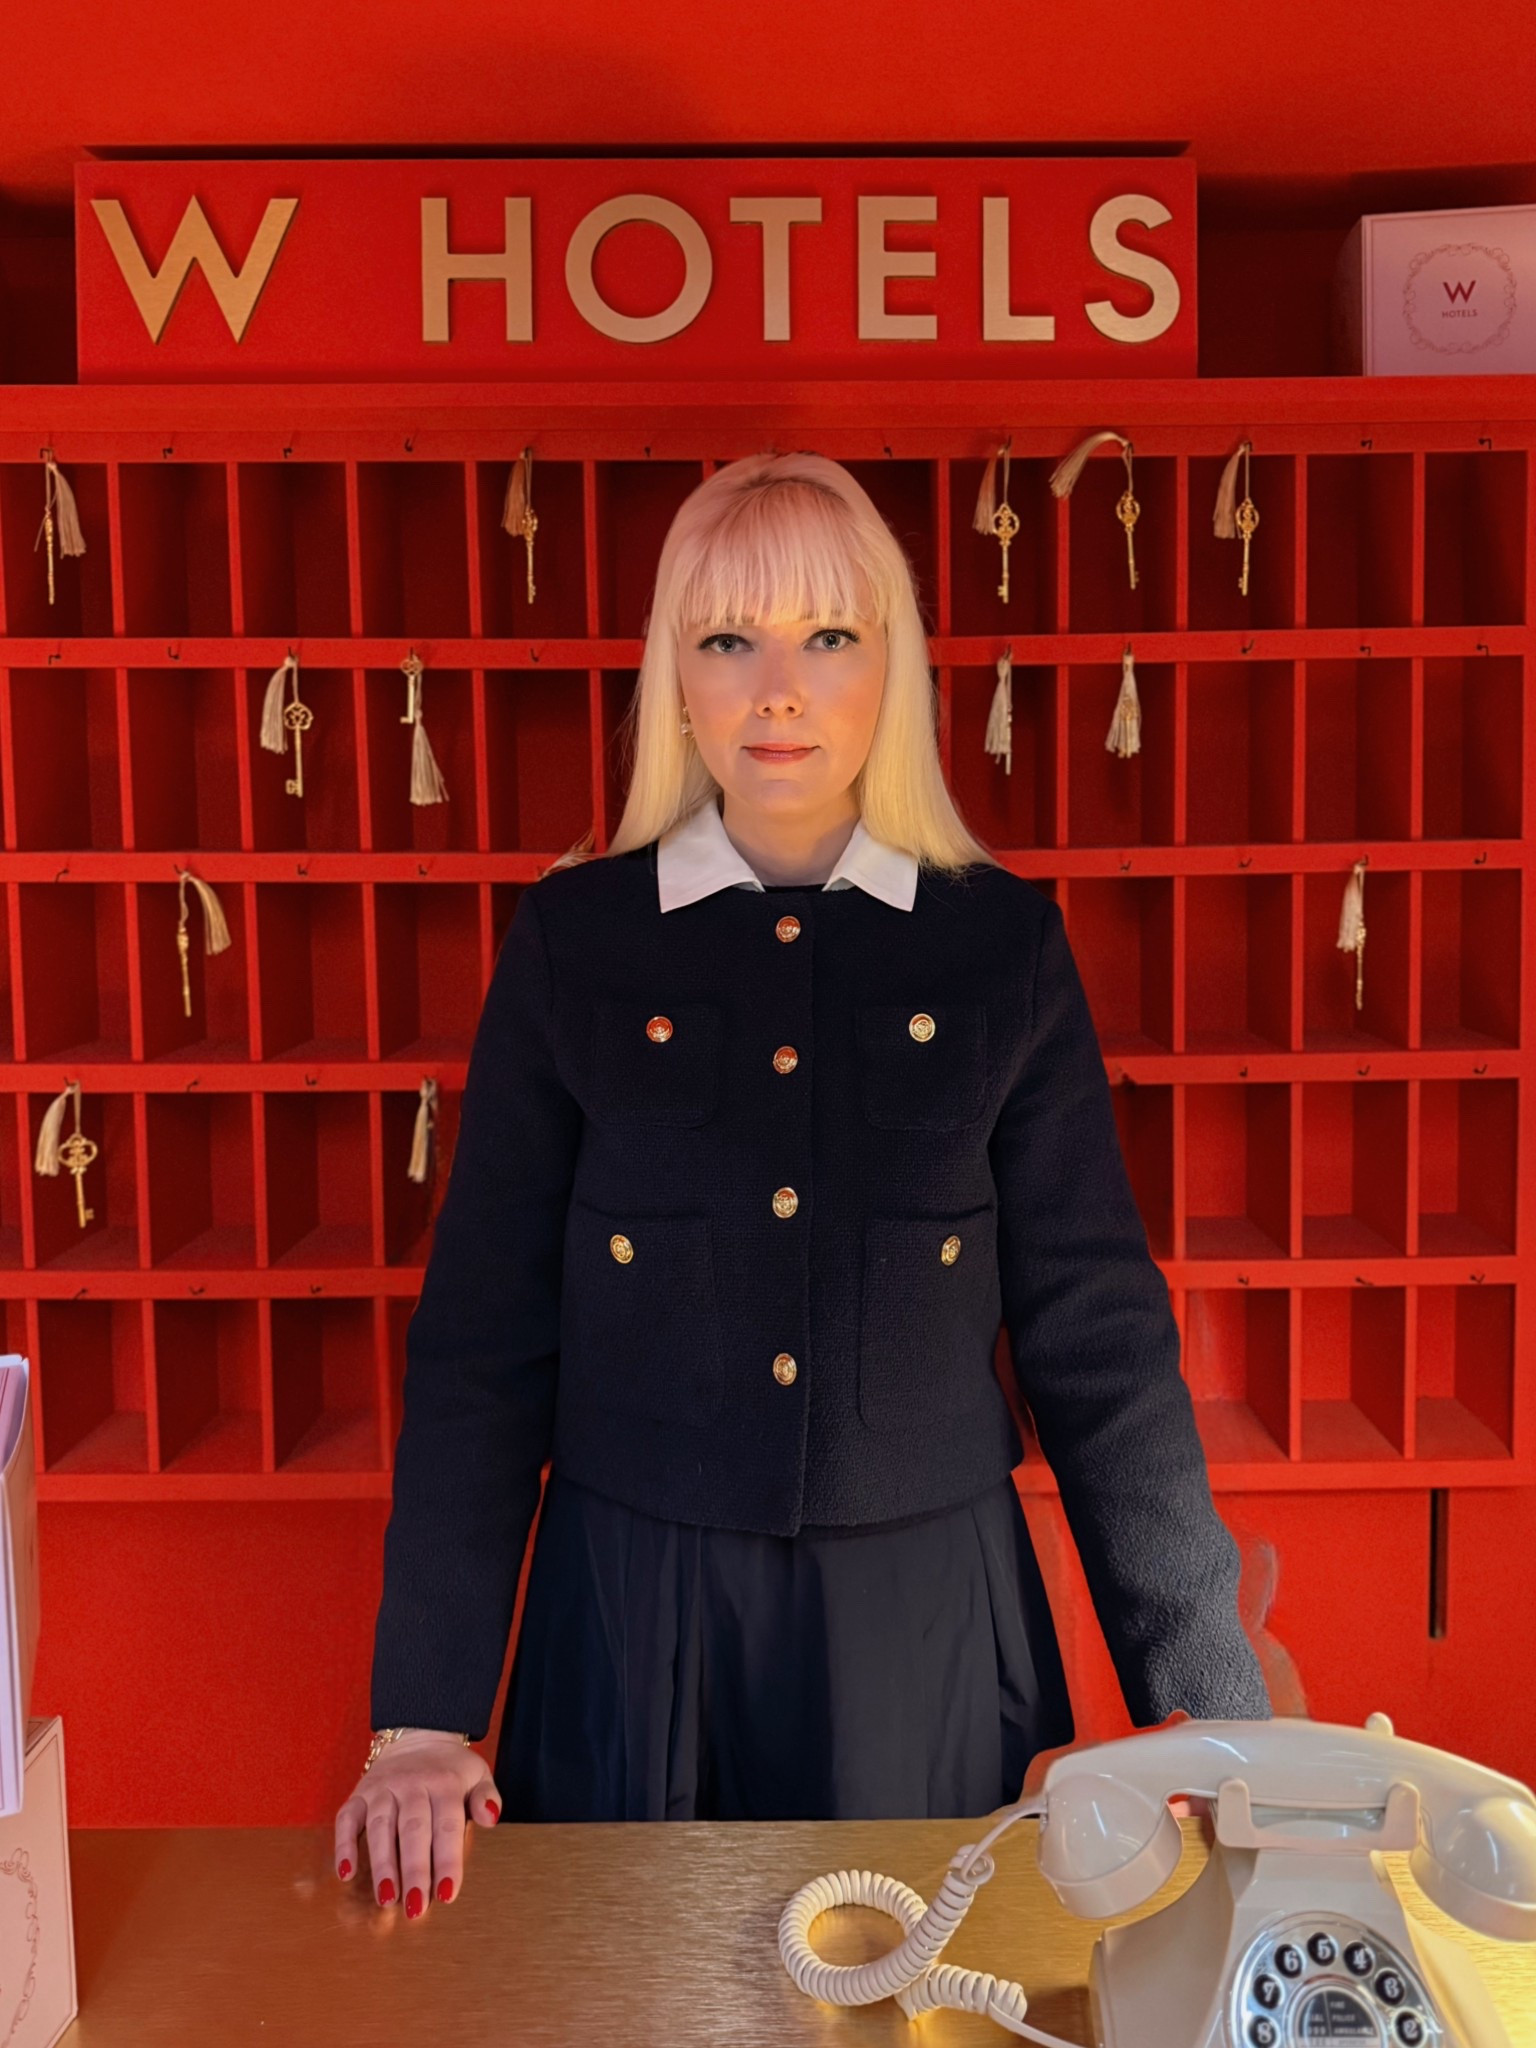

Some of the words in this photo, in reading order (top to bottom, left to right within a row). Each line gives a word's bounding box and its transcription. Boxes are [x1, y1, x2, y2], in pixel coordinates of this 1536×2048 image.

[89, 194, 299, 346] W
[420, 193, 1181, 344] HOTELS
[1443, 280, 1476, 304] W
[1441, 309, 1478, 318] HOTELS
[1317, 1939, 1331, 1959] 5
[1353, 1948, 1367, 1969] 4
[1284, 1951, 1299, 1971] 6
[1262, 1981, 1275, 2000] 7
[1384, 1977, 1399, 1999] 3
[1257, 2022, 1272, 2043] 8
[1402, 2019, 1418, 2039] 2
